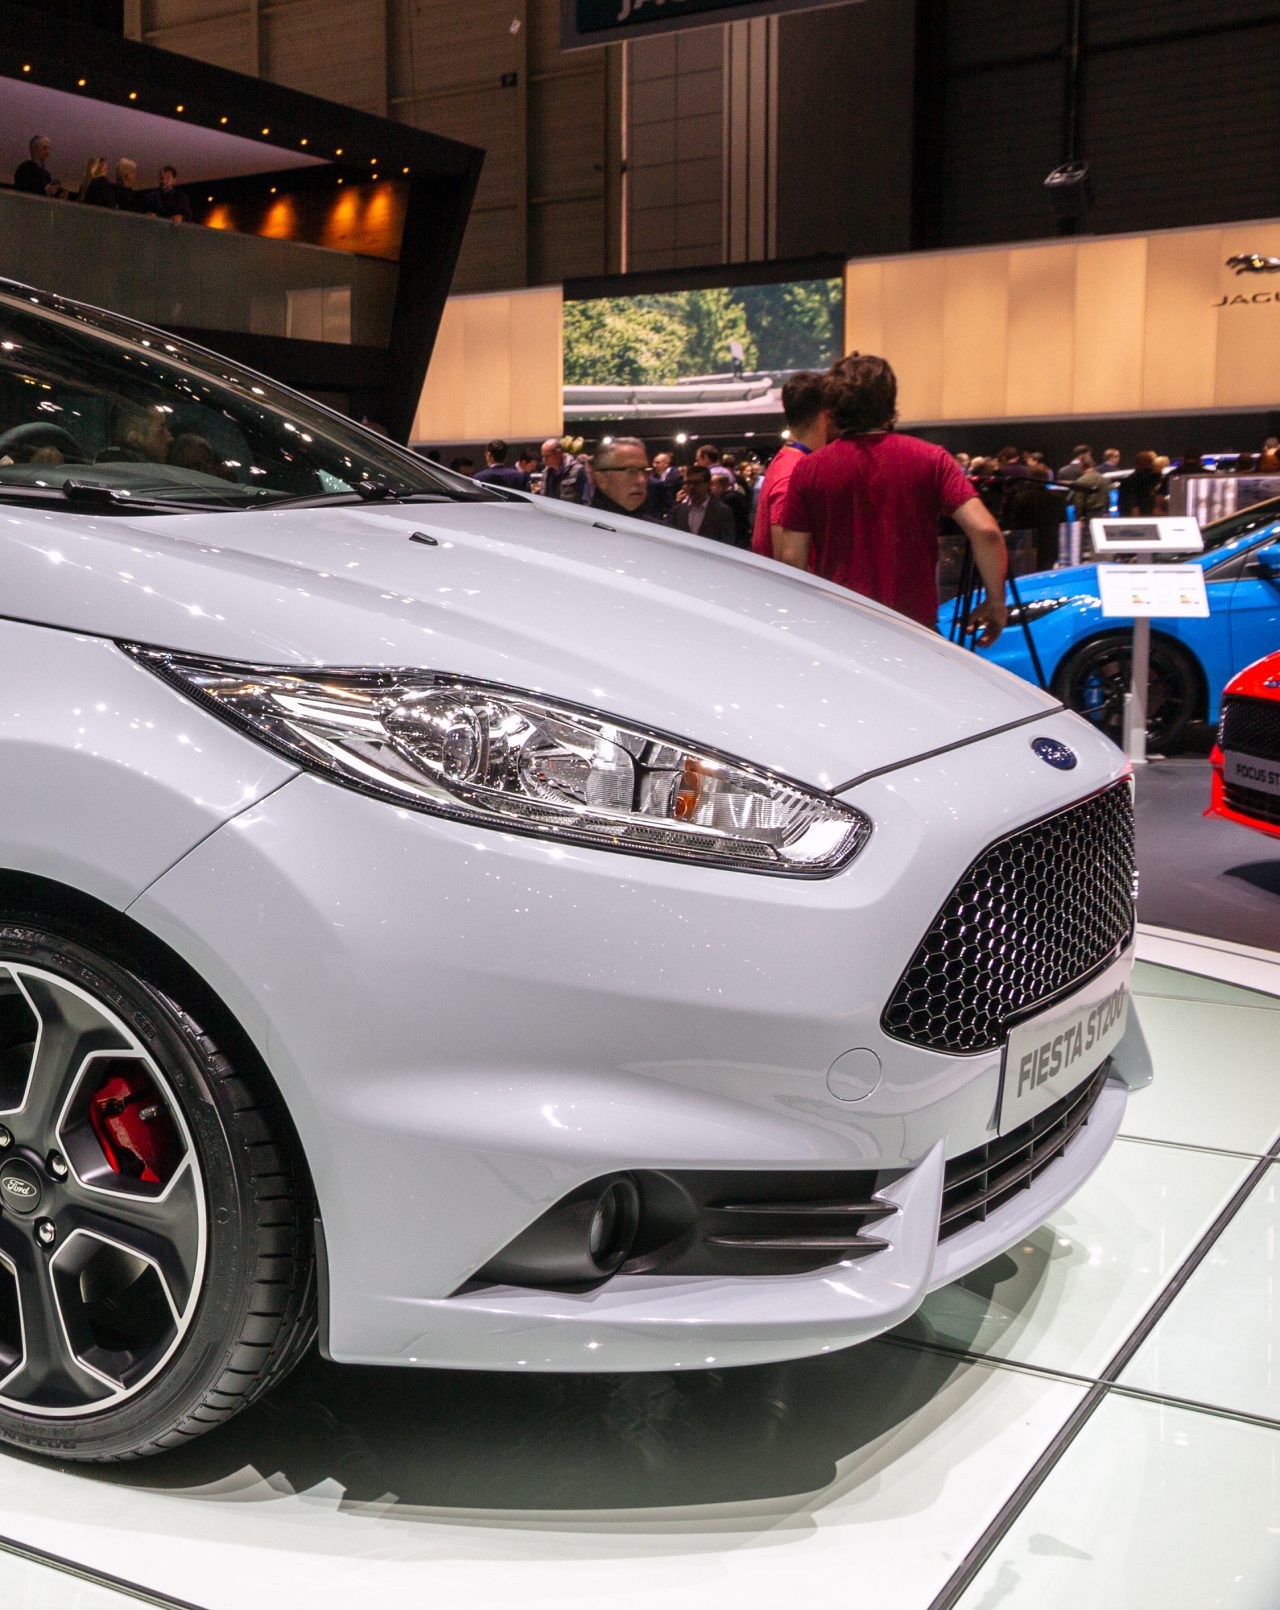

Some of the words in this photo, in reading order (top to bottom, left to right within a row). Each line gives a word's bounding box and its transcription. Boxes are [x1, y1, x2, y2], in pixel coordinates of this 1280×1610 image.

[1212, 292, 1280, 307] JAG
[1236, 763, 1267, 783] FOCUS
[1017, 1021, 1083, 1098] FIESTA
[1084, 983, 1125, 1051] ST200
[7, 1179, 31, 1195] Ford
